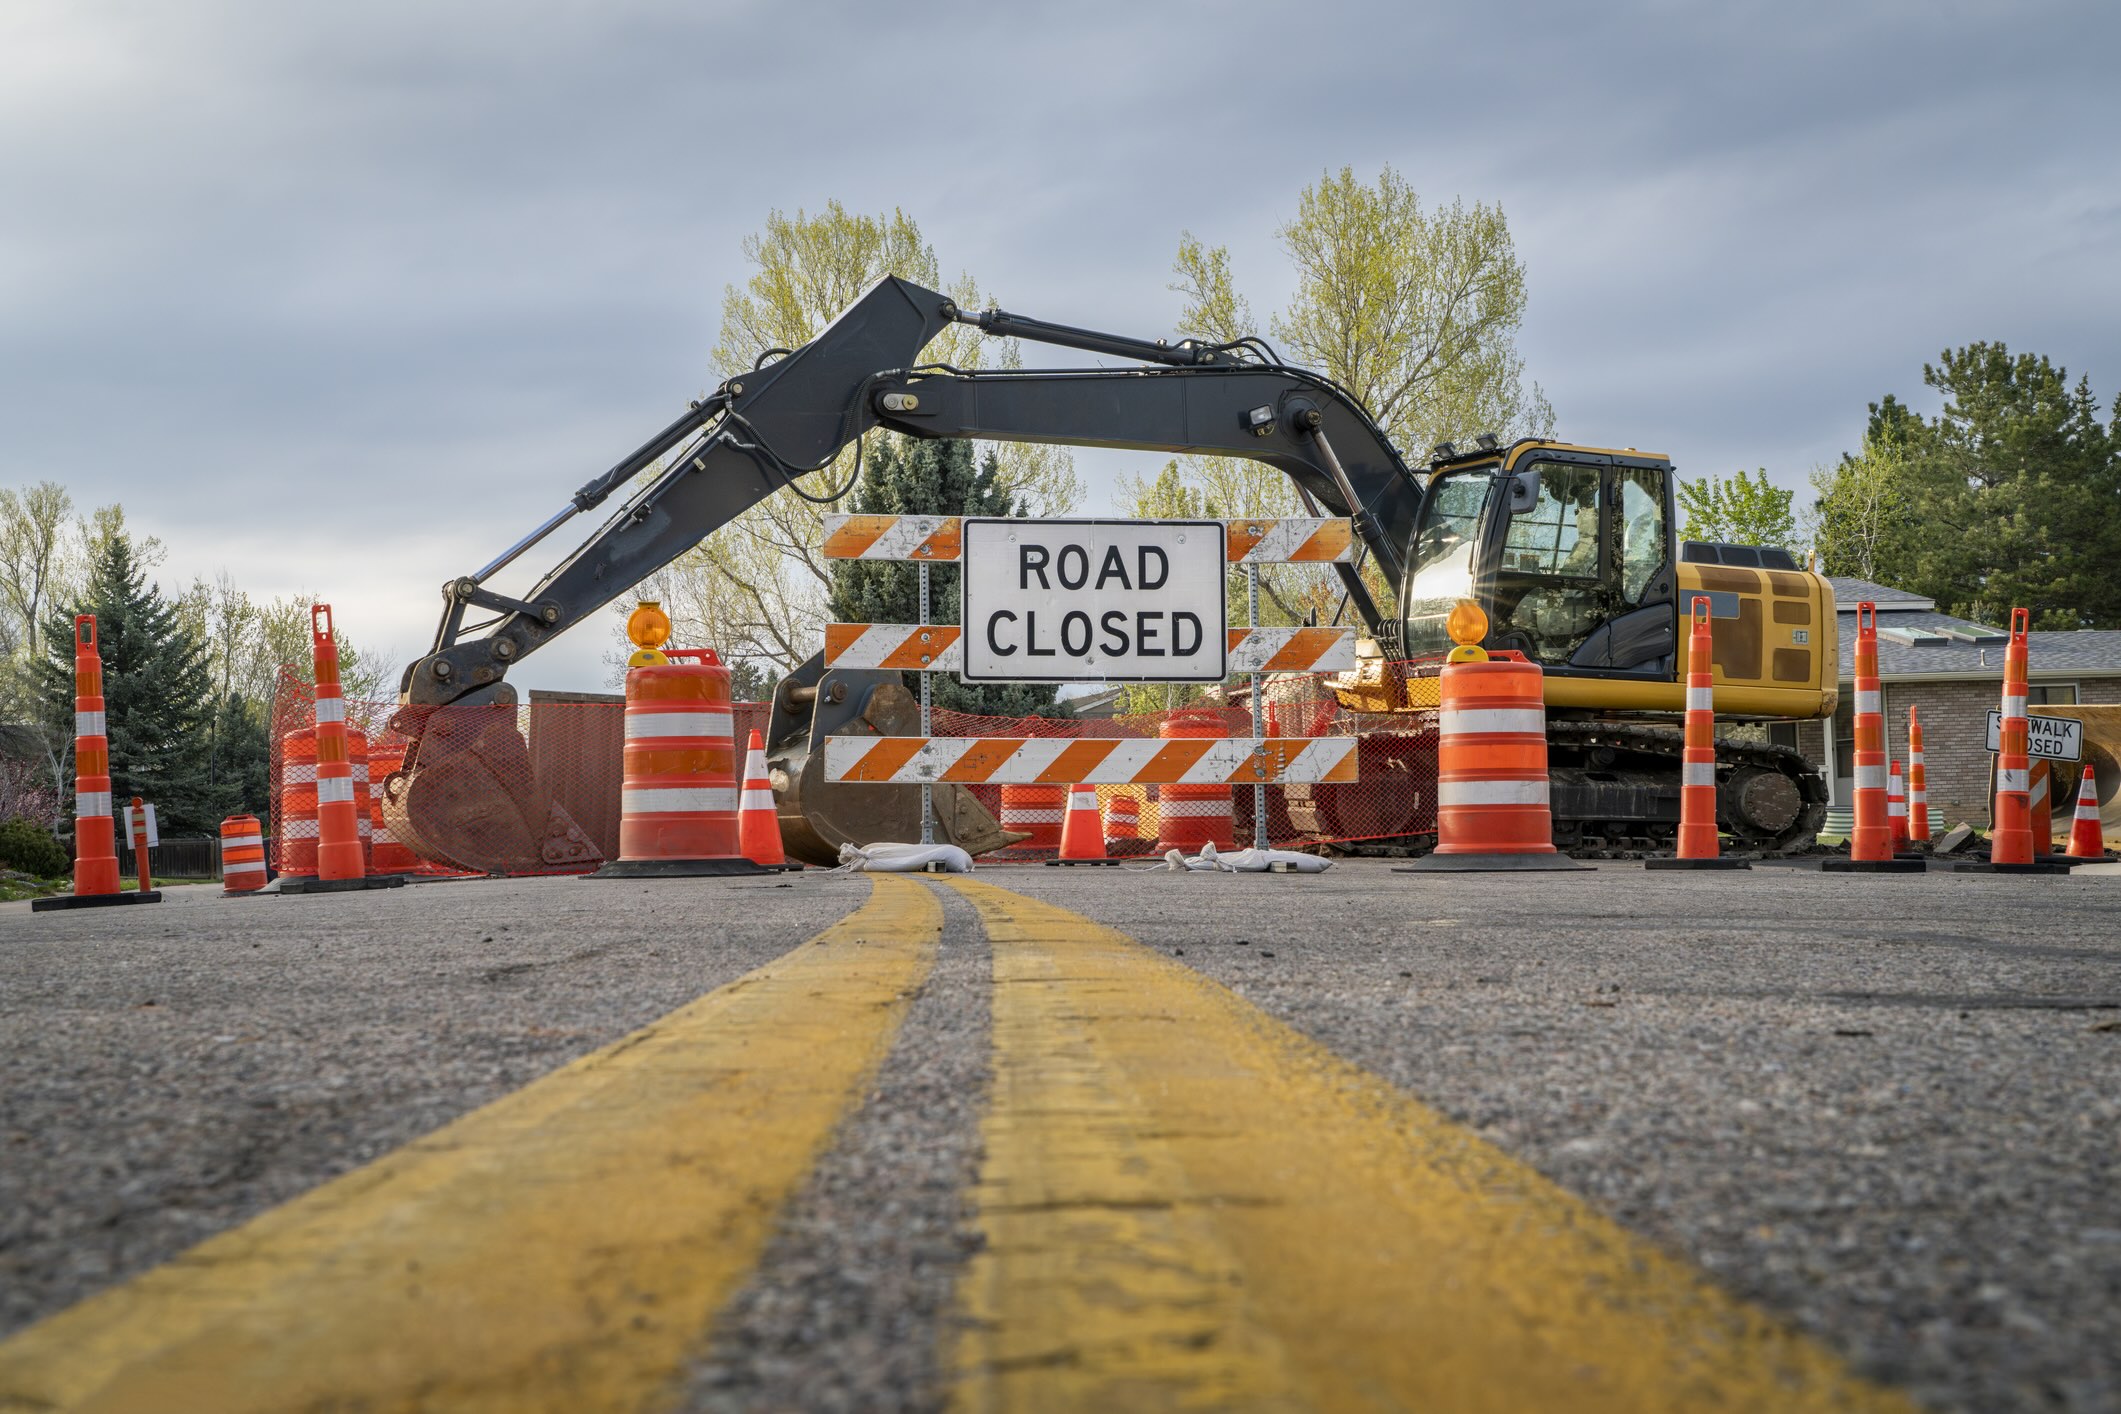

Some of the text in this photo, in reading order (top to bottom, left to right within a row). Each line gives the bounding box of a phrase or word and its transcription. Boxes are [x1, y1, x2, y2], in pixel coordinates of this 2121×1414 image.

[1019, 544, 1169, 590] ROAD
[987, 610, 1203, 657] CLOSED
[1996, 715, 2072, 738] SWALK
[2028, 738, 2063, 755] OSED
